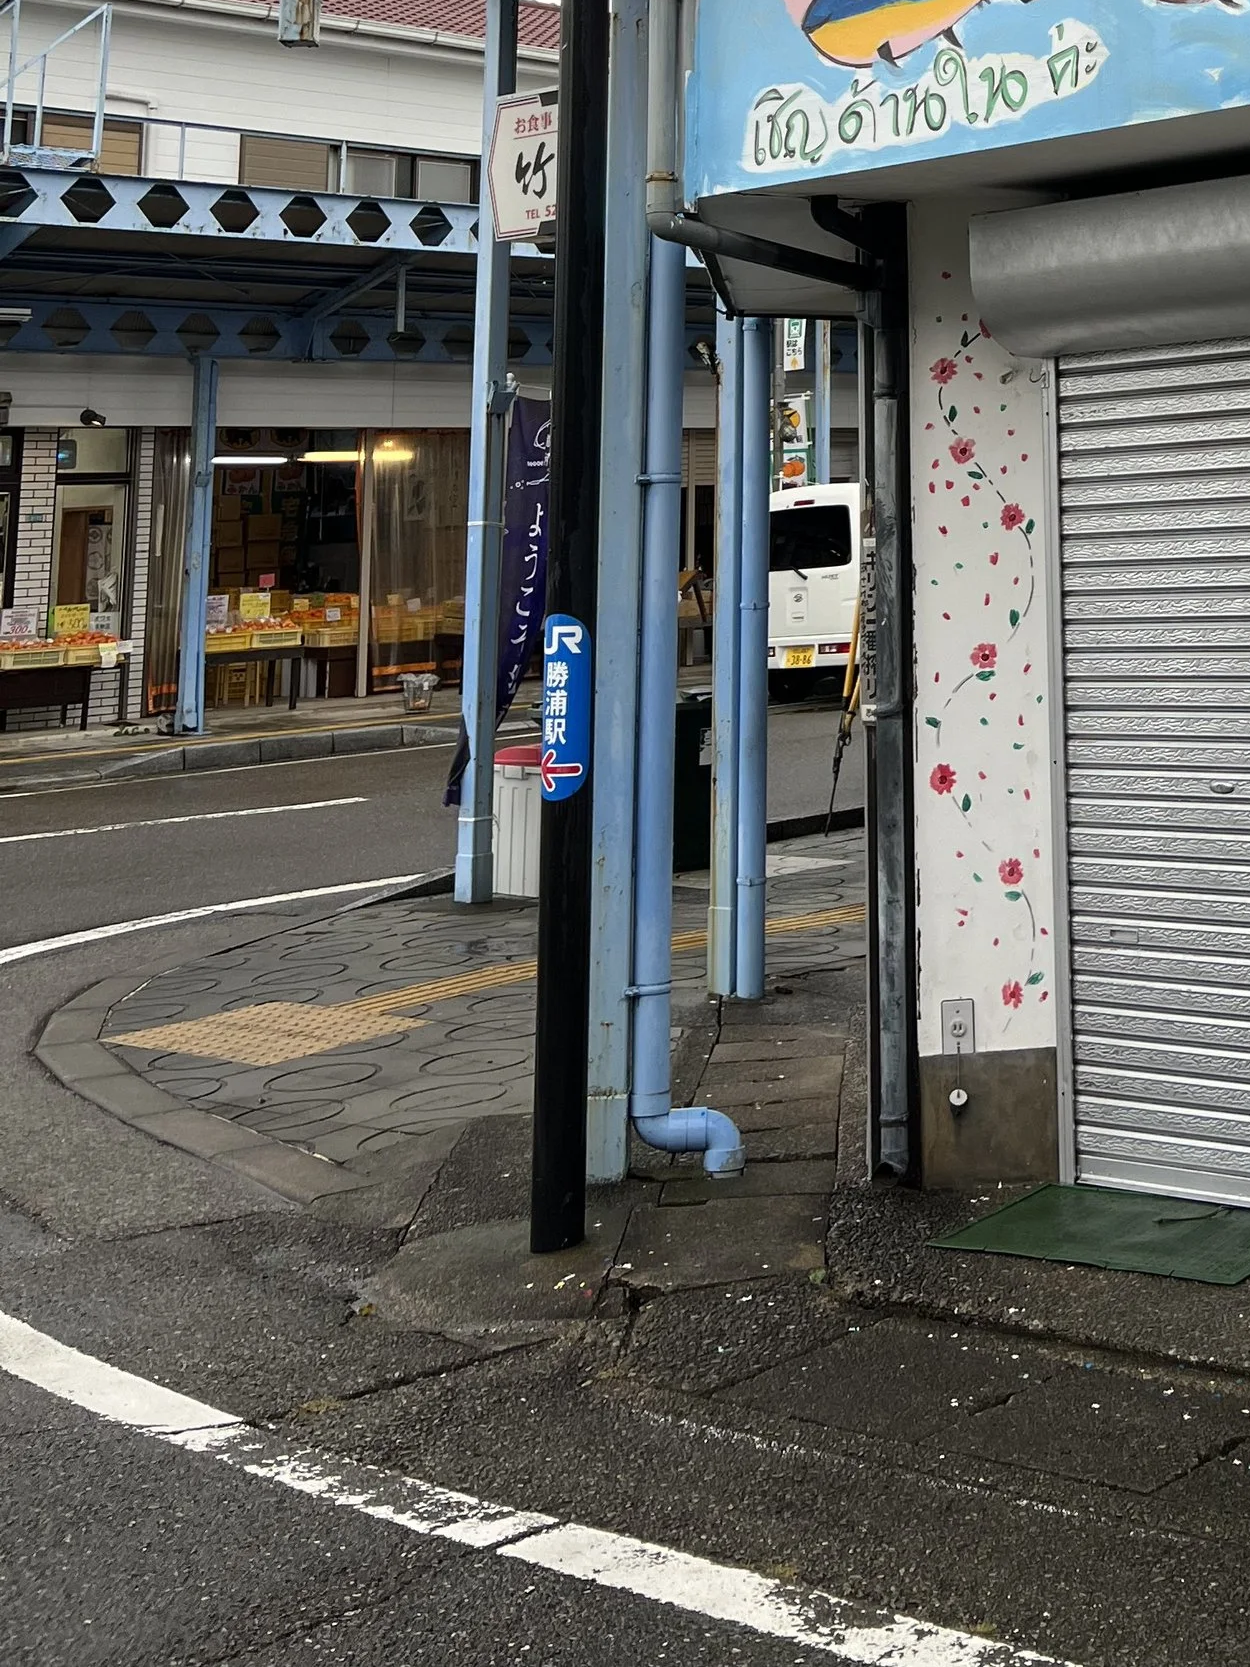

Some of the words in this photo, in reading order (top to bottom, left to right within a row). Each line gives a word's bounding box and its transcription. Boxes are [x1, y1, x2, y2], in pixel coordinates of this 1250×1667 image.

[513, 110, 553, 135] お食事
[525, 209, 541, 220] TEL
[786, 347, 803, 357] こちら
[544, 624, 584, 655] JR
[544, 660, 570, 746] 勝浦駅
